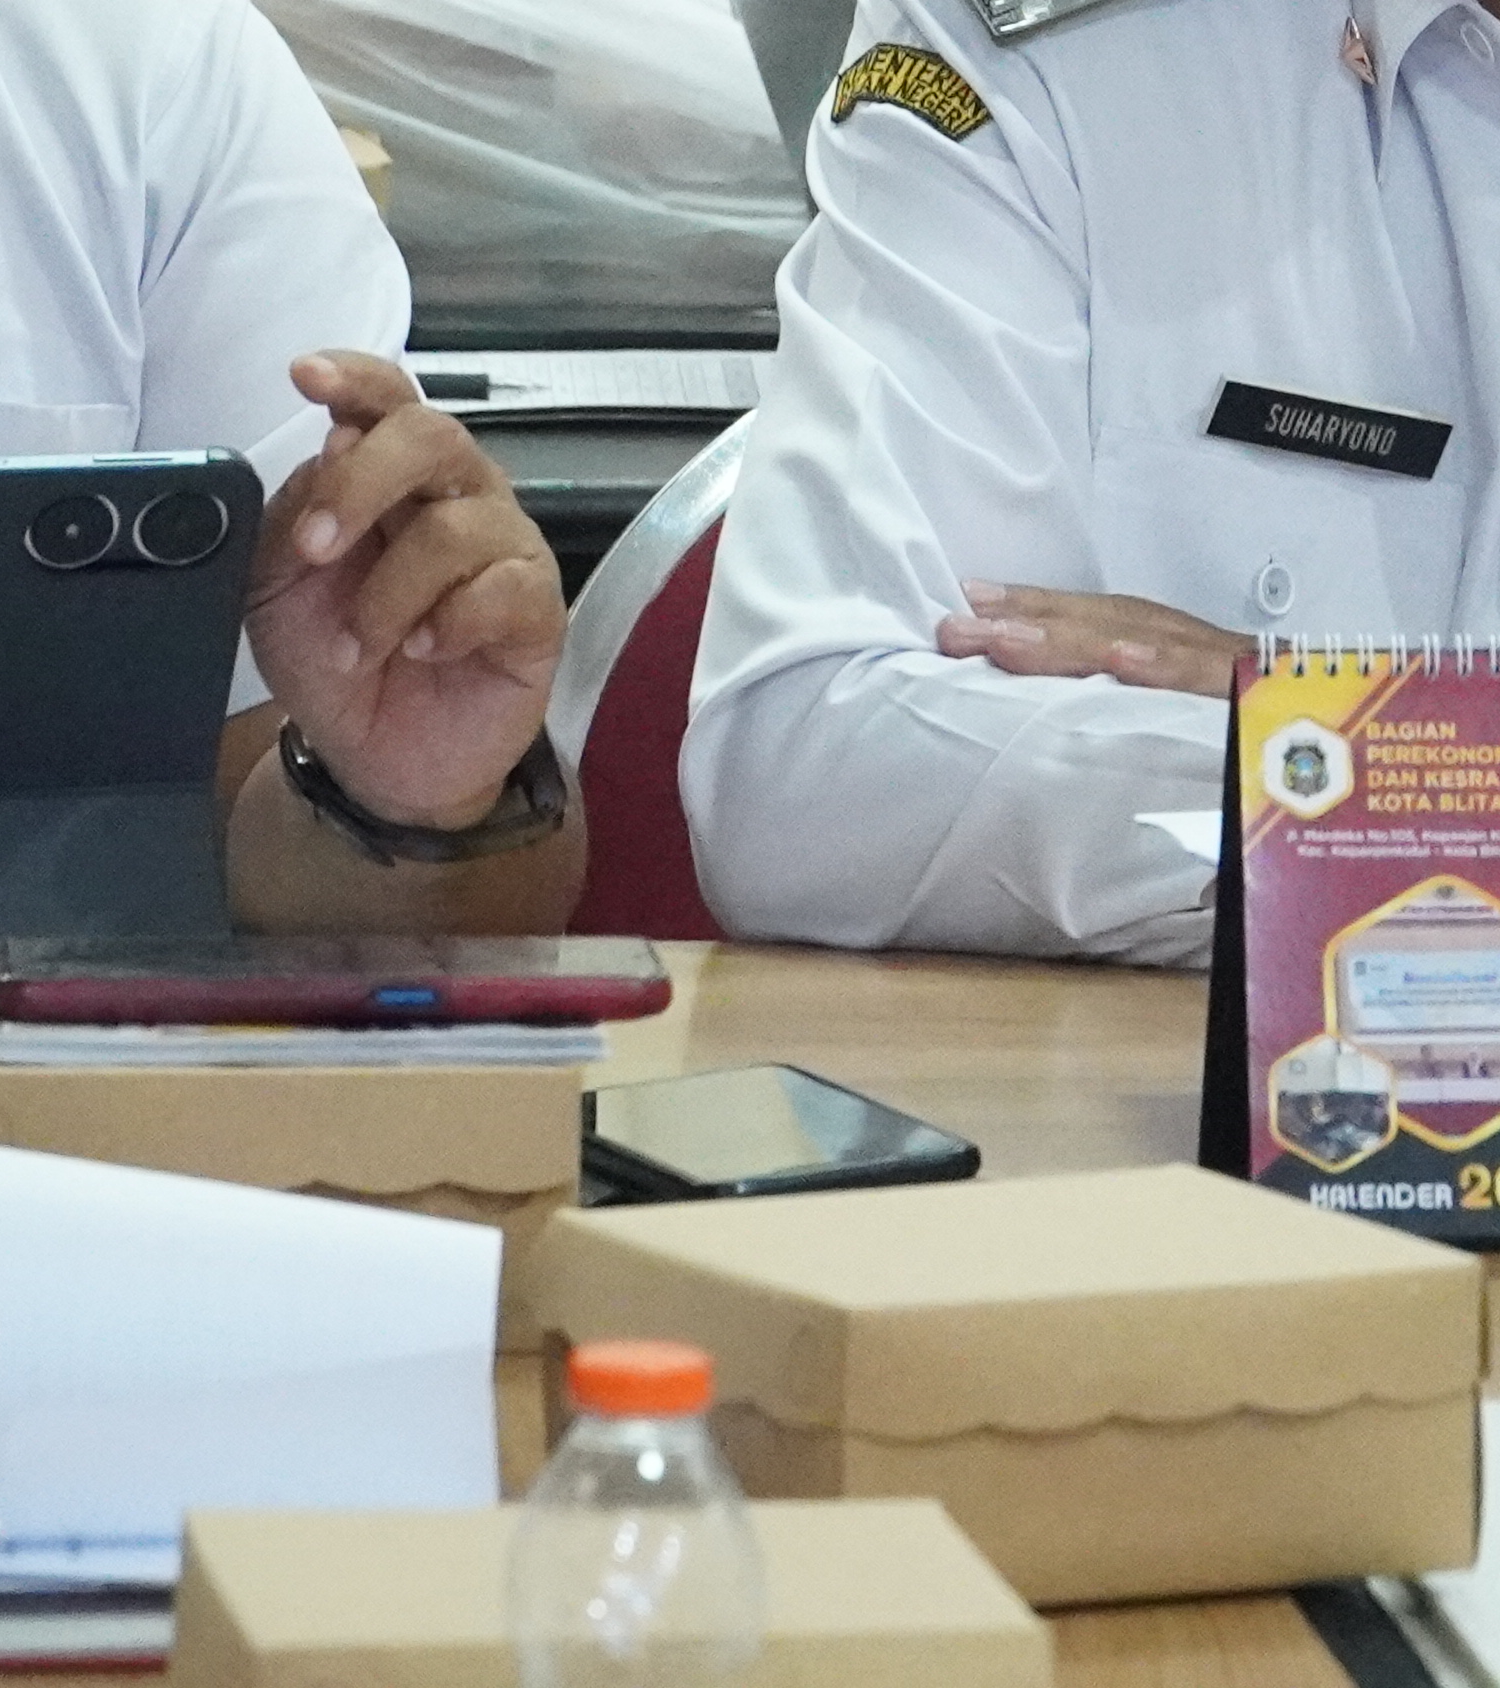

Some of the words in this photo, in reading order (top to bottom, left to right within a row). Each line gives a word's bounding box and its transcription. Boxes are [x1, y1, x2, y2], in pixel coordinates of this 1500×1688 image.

[1265, 402, 1397, 456] SUHARYONO
[1366, 721, 1456, 740] BAGIAN
[1366, 770, 1418, 788] DAN
[1423, 769, 1500, 788] KESRA
[1366, 793, 1433, 812] KOTA
[1309, 1182, 1454, 1211] KALENDER
